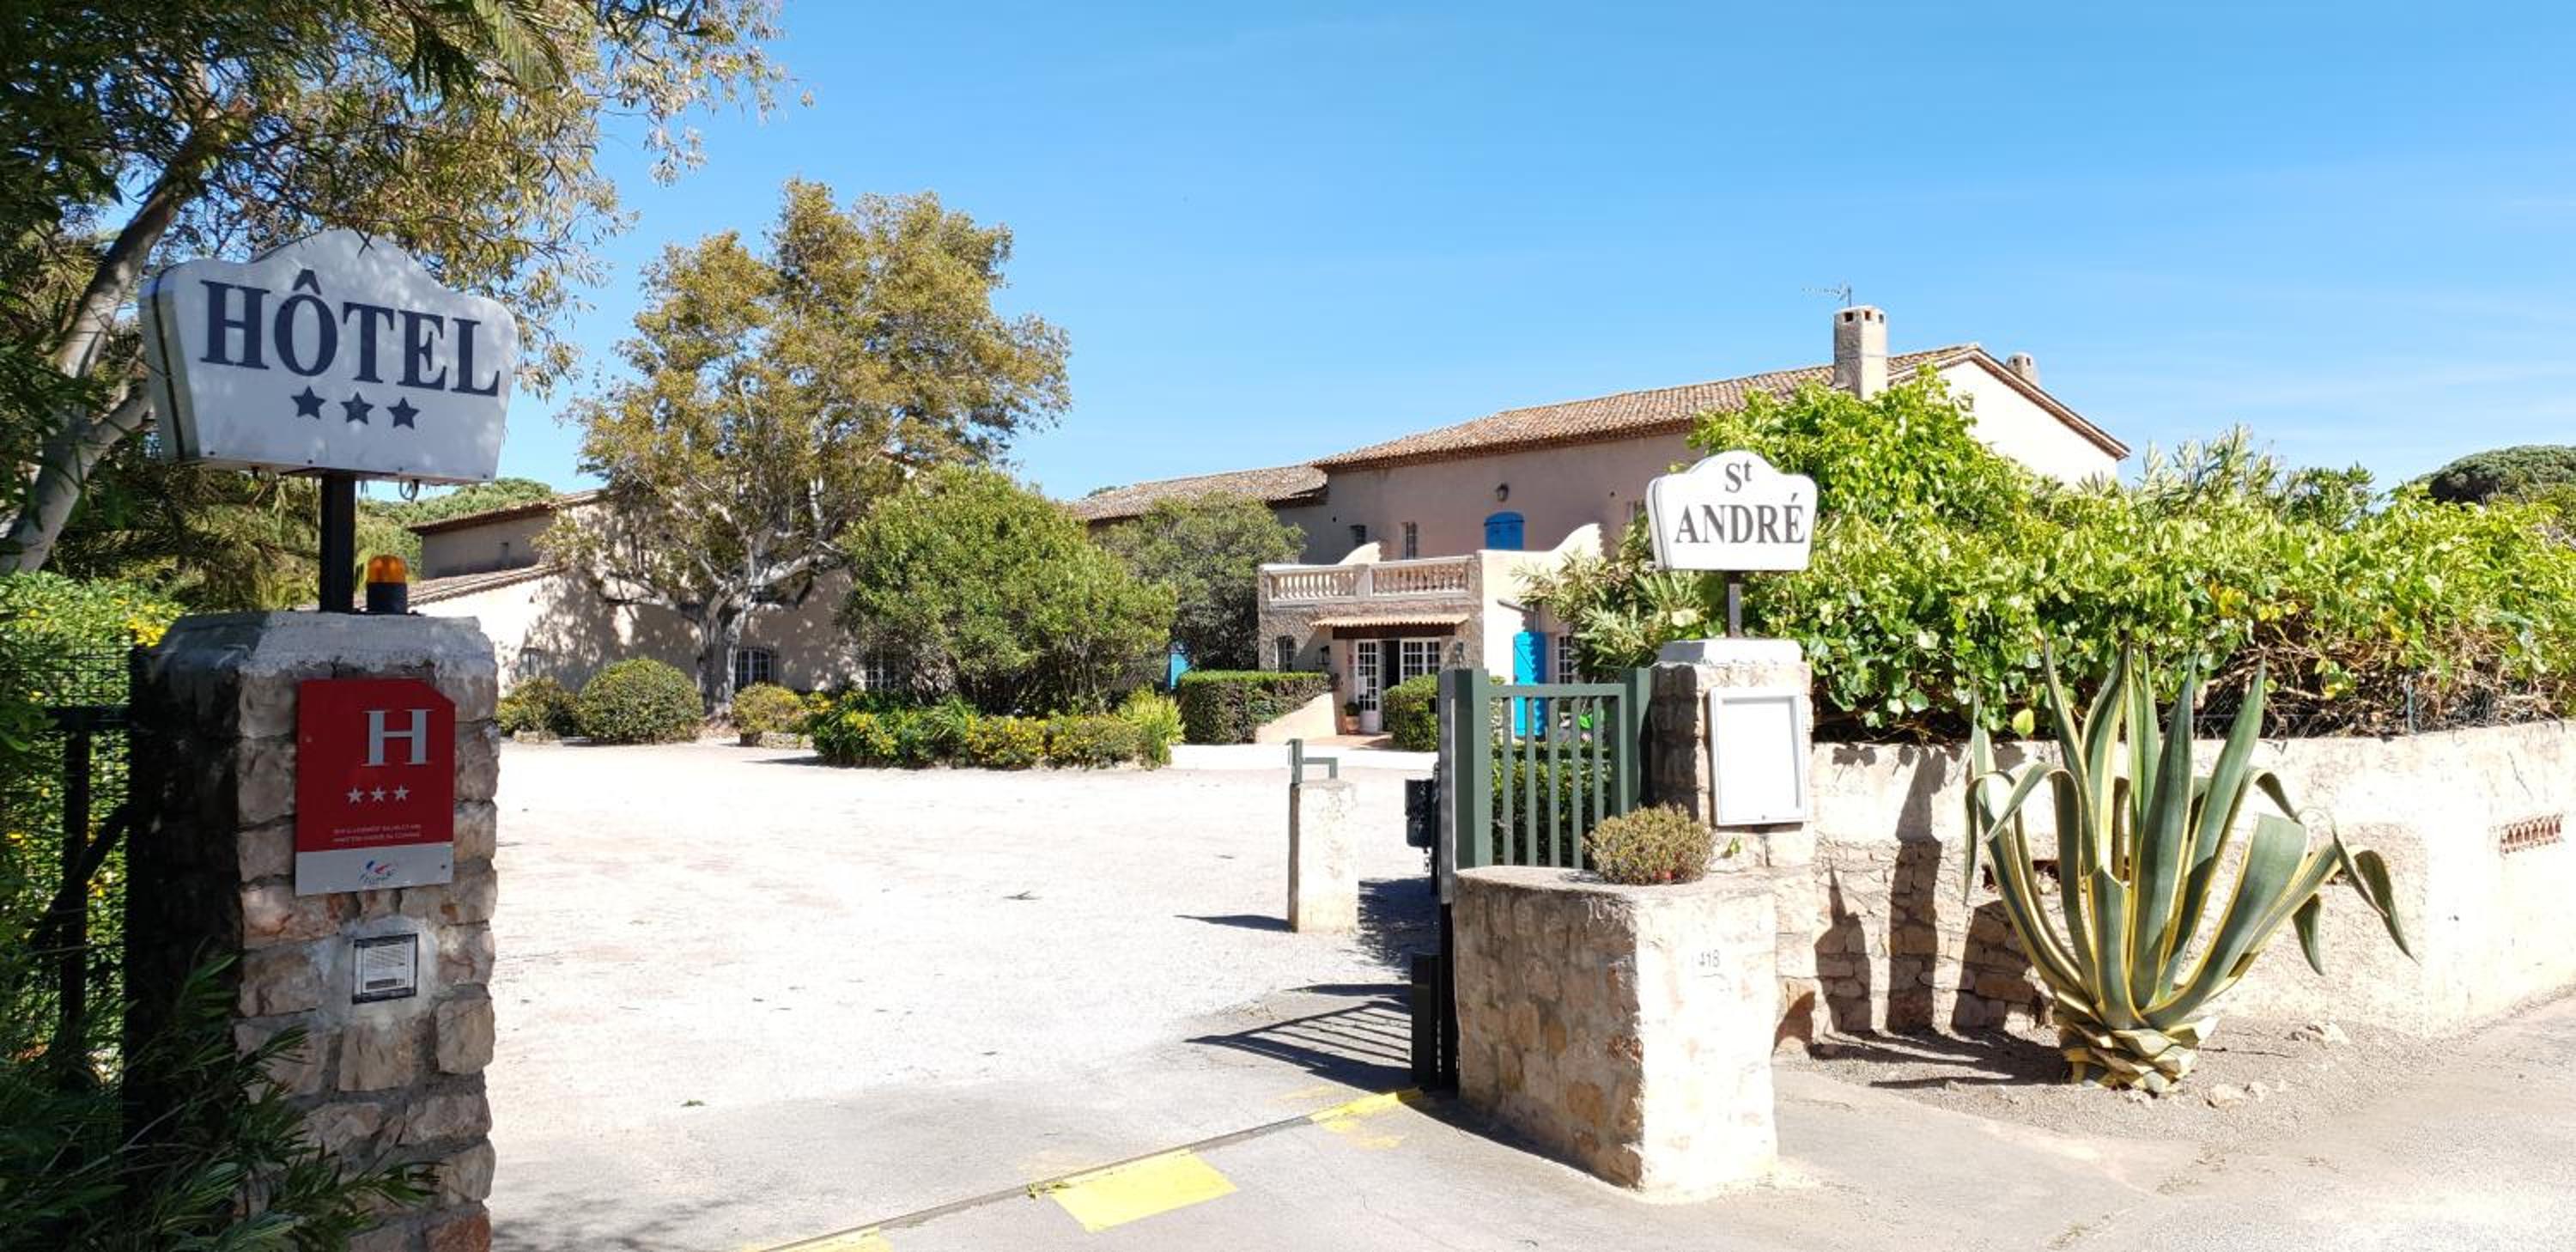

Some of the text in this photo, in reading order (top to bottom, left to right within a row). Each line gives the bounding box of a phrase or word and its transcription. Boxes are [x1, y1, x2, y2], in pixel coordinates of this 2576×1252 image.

[199, 269, 501, 397] HÔTEL
[1724, 459, 1753, 493] St
[1674, 492, 1806, 544] ANDRÉ
[361, 708, 434, 767] H
